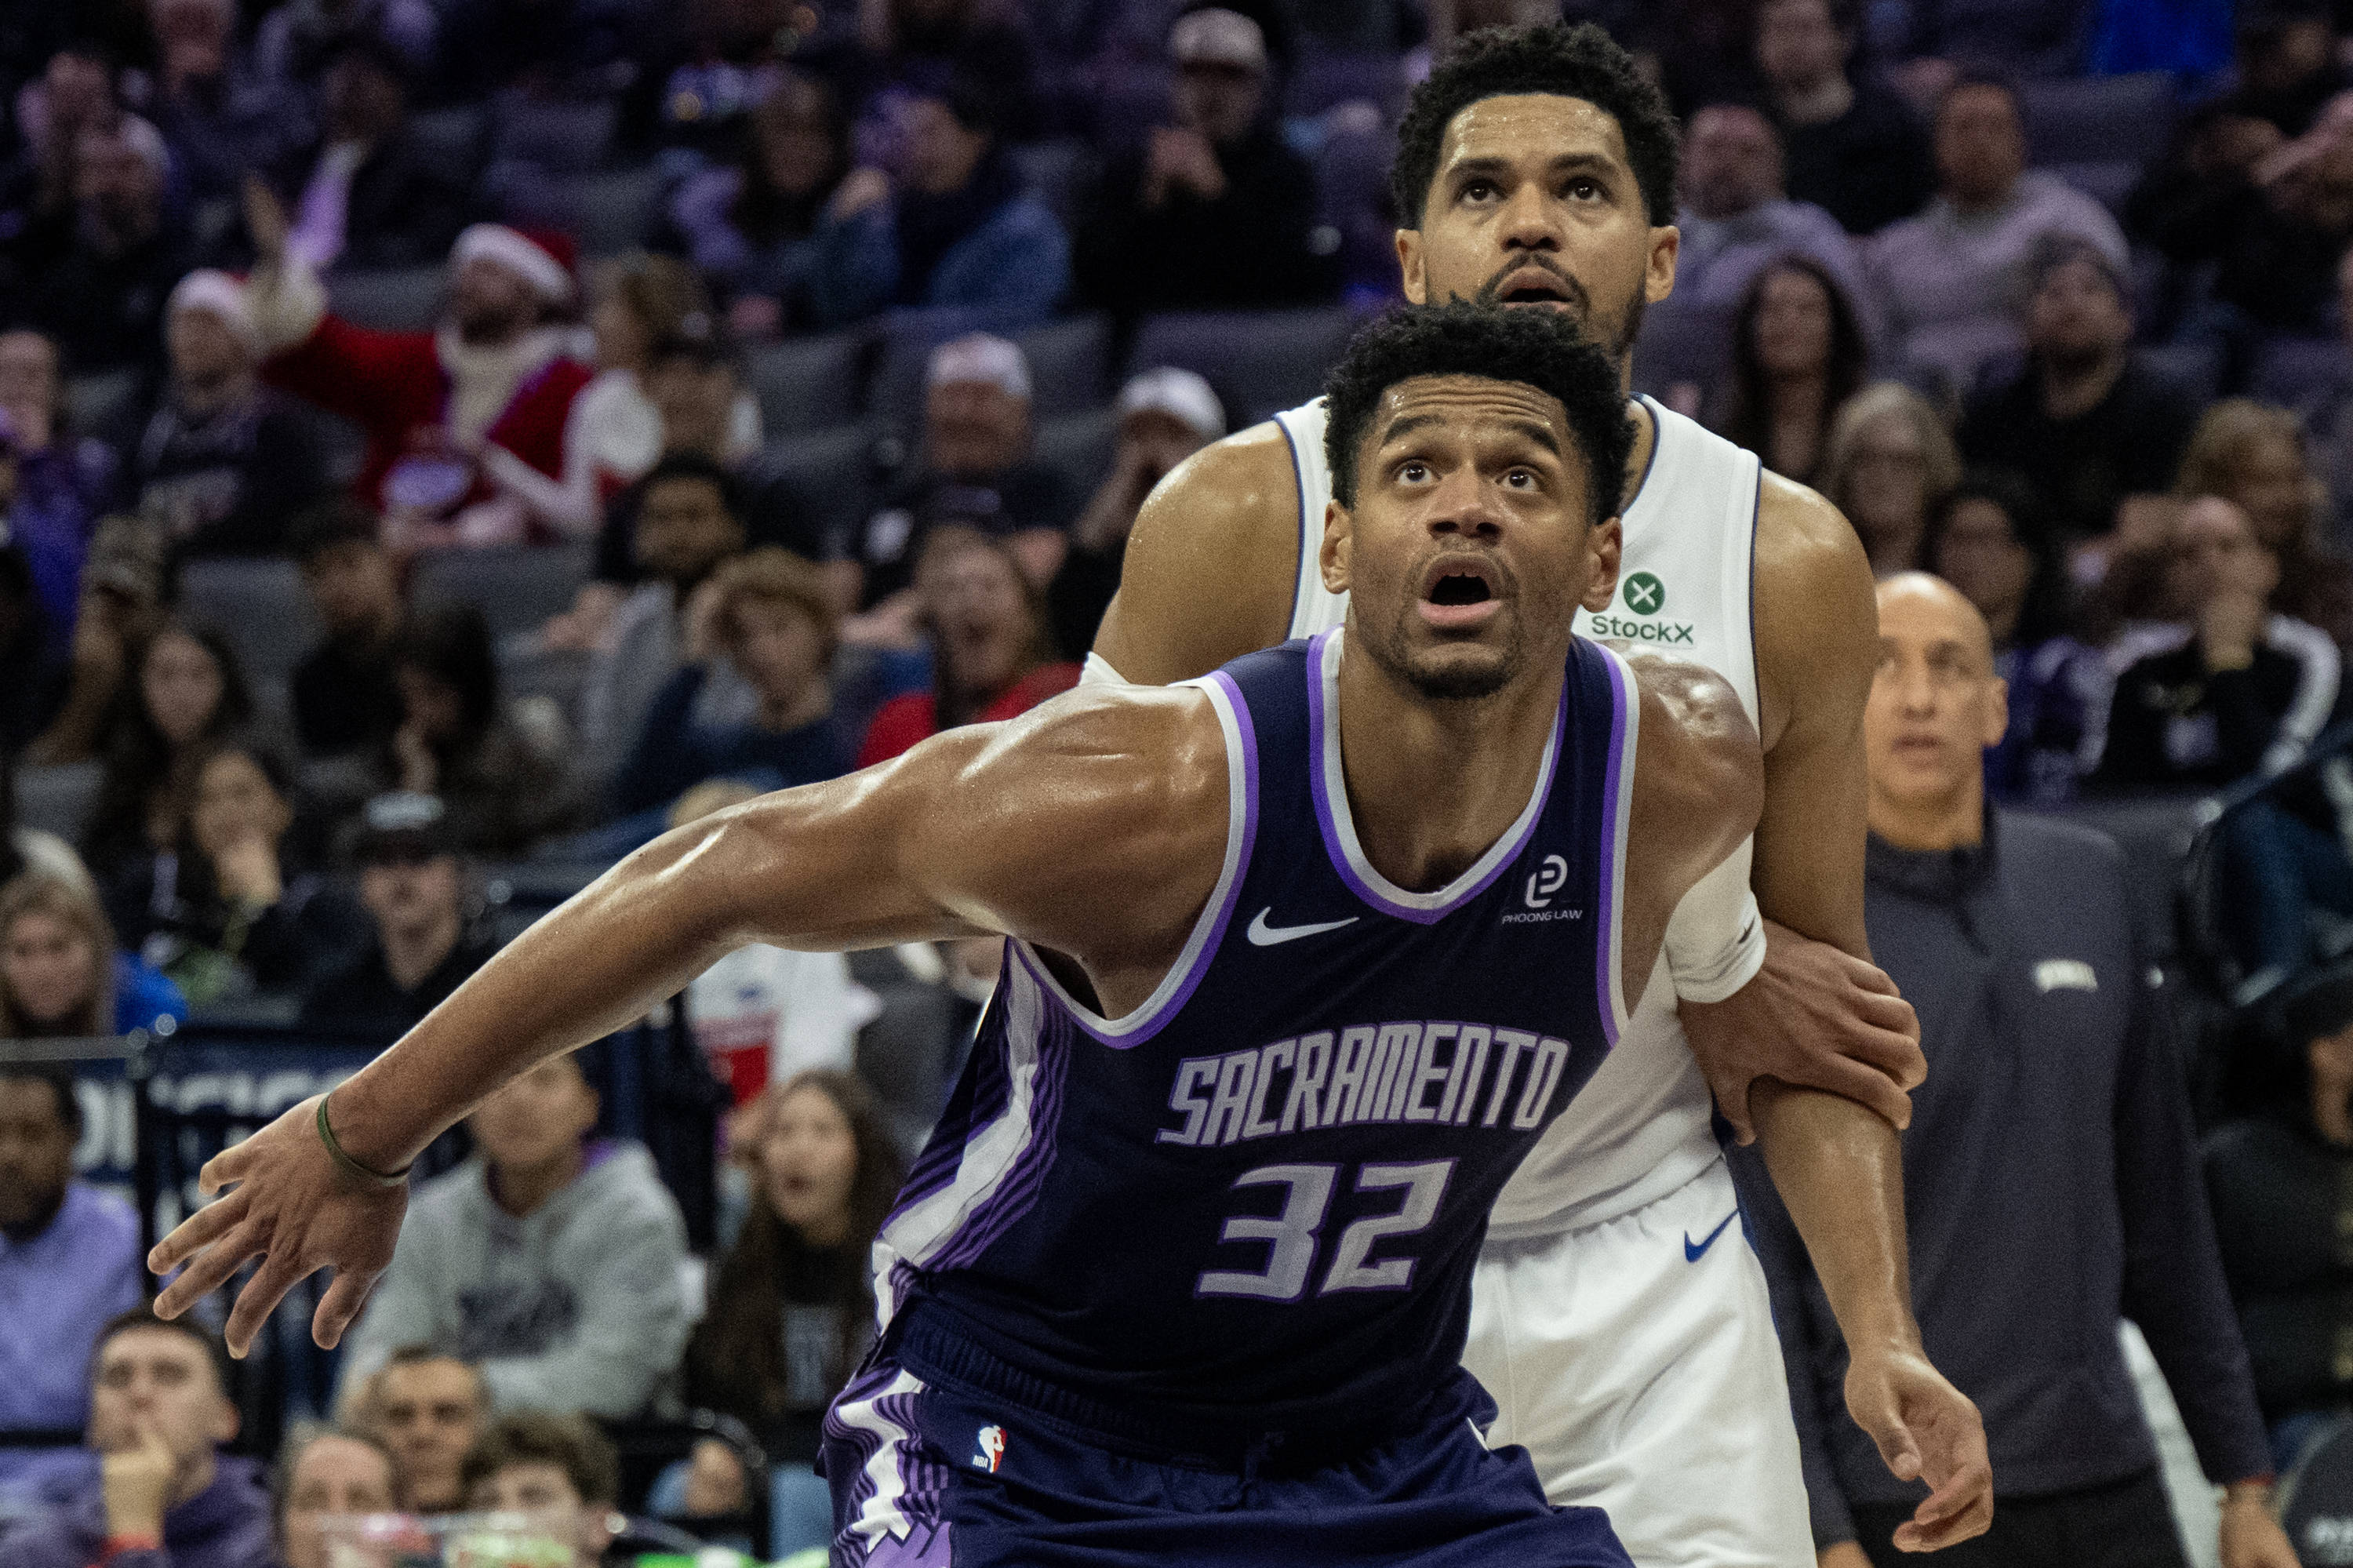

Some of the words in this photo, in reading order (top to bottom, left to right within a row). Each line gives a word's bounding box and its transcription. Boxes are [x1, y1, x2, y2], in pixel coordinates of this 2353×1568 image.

[1592, 615, 1693, 644] StockX
[1501, 911, 1552, 924] PHOONG
[1555, 909, 1583, 919] LAW
[1155, 1020, 1570, 1148] SACRAMENTO
[1194, 1158, 1459, 1304] 32
[973, 1454, 988, 1468] NBA
